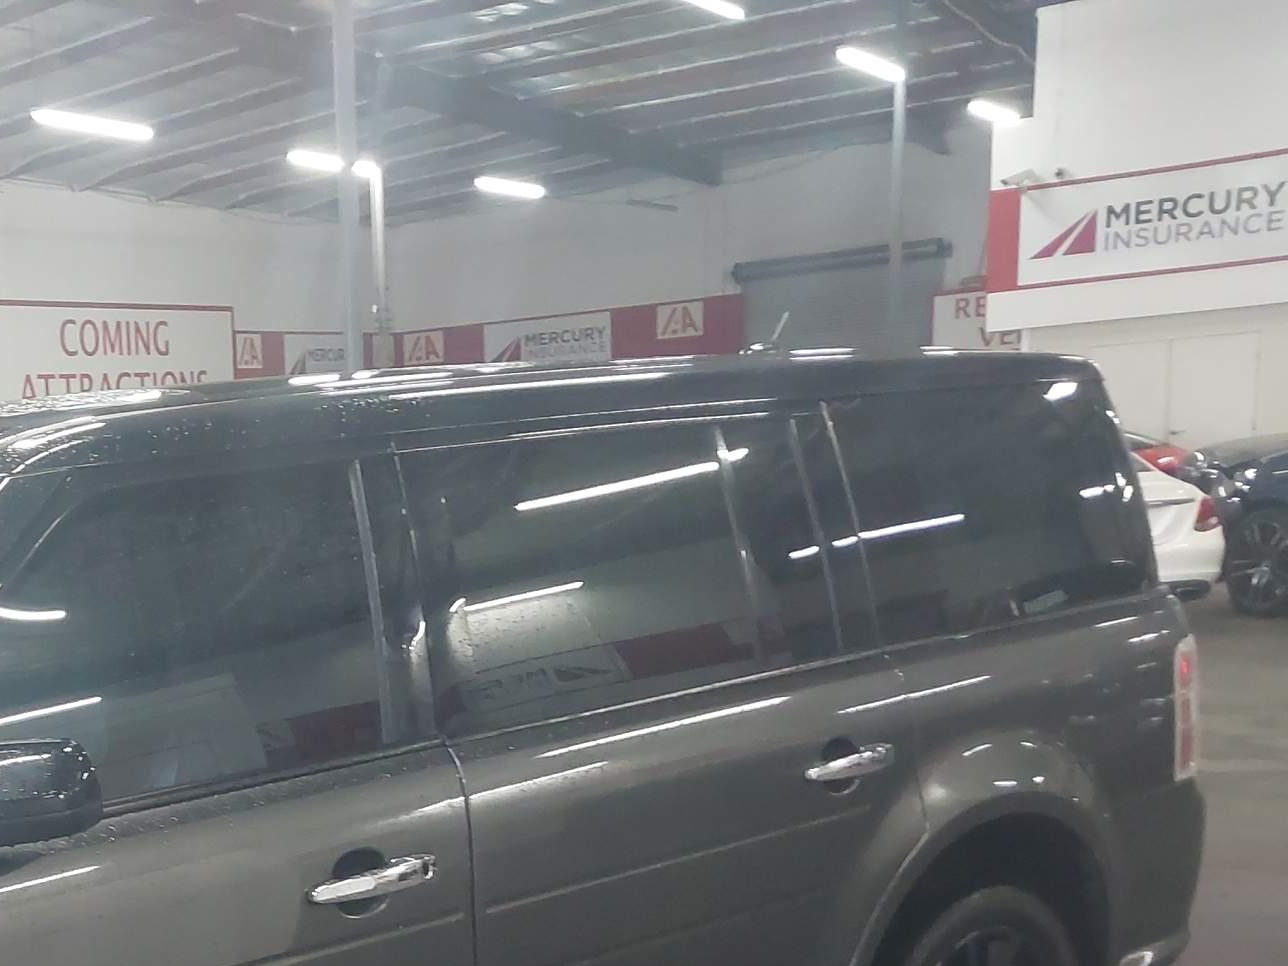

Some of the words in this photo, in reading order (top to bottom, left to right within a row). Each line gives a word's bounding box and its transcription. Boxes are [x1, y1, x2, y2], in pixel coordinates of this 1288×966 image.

[1105, 181, 1288, 228] MERCURY
[1103, 209, 1286, 250] INSURANCE
[60, 319, 170, 356] COMING
[523, 326, 606, 347] MERCURY
